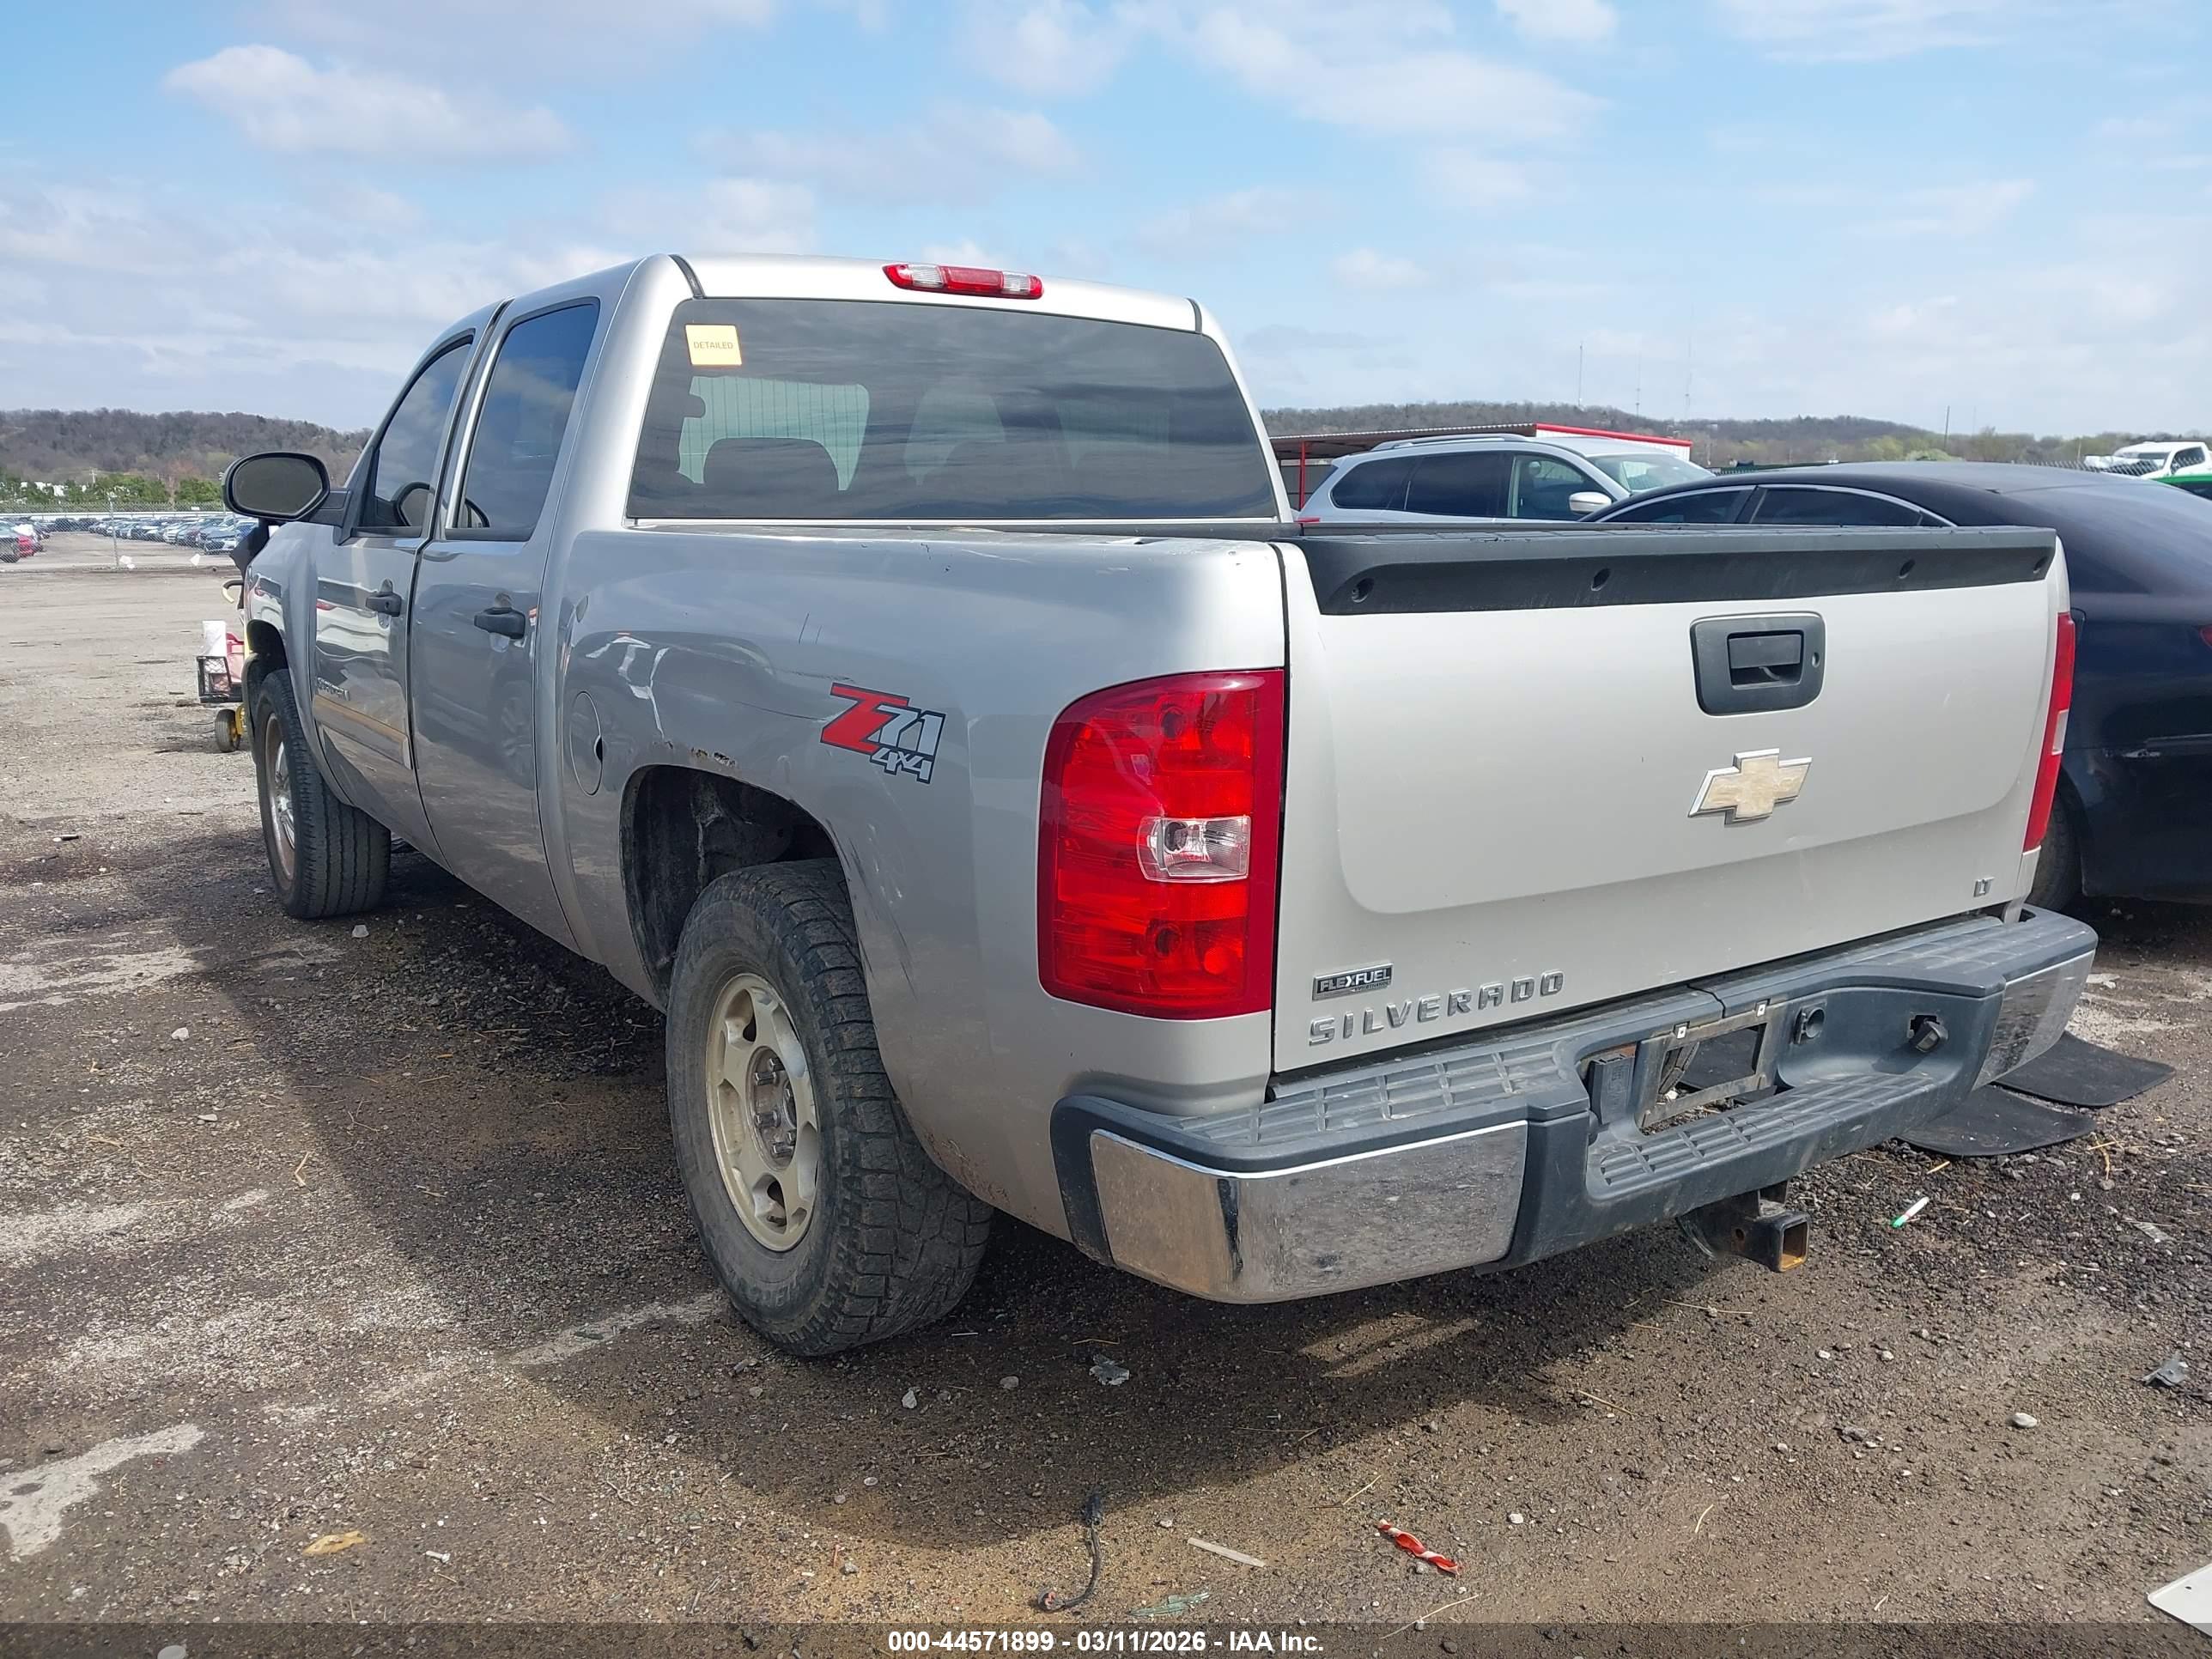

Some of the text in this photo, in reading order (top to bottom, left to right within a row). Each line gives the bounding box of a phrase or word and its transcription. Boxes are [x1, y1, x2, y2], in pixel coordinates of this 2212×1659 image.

[693, 341, 733, 350] DETAILED
[820, 682, 946, 759] Z71
[1320, 969, 1390, 992] FLEXFUEL
[1309, 969, 1565, 1047] SILVERADO
